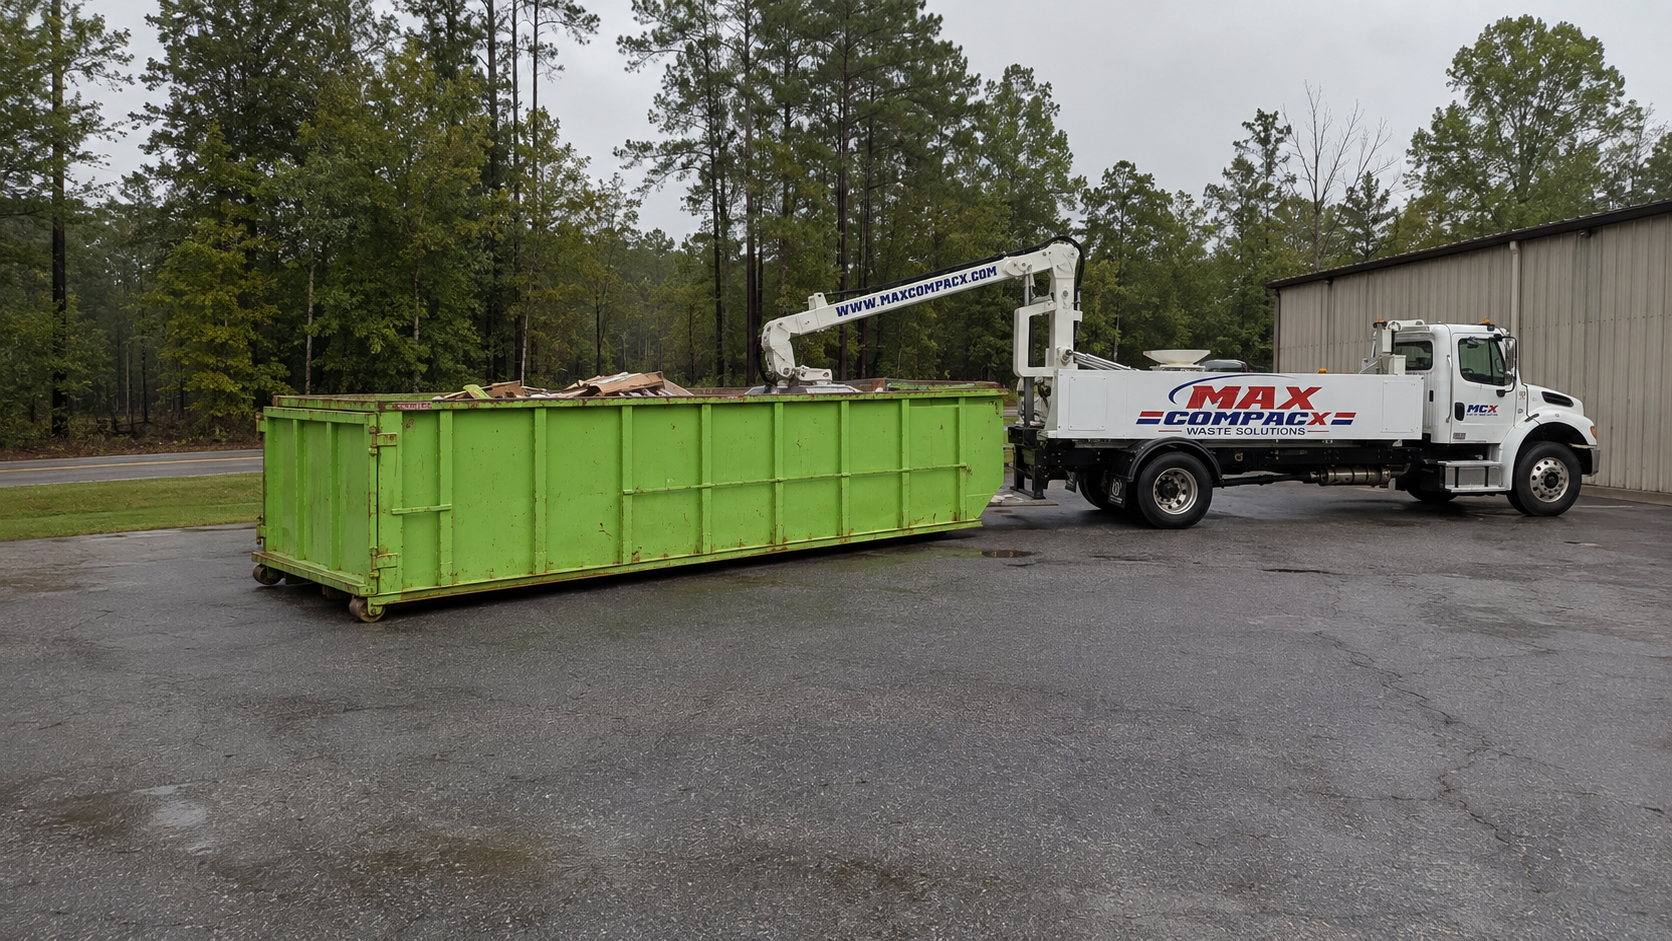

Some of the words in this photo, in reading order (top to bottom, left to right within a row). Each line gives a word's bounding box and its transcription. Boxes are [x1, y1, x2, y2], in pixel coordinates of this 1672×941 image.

[836, 266, 997, 317] WWW.MAXCOMPACX.COM
[1186, 386, 1323, 409] MAX
[1467, 405, 1498, 413] MCX
[1187, 427, 1231, 436] WASTE
[1236, 427, 1306, 436] SOLUTIONS
